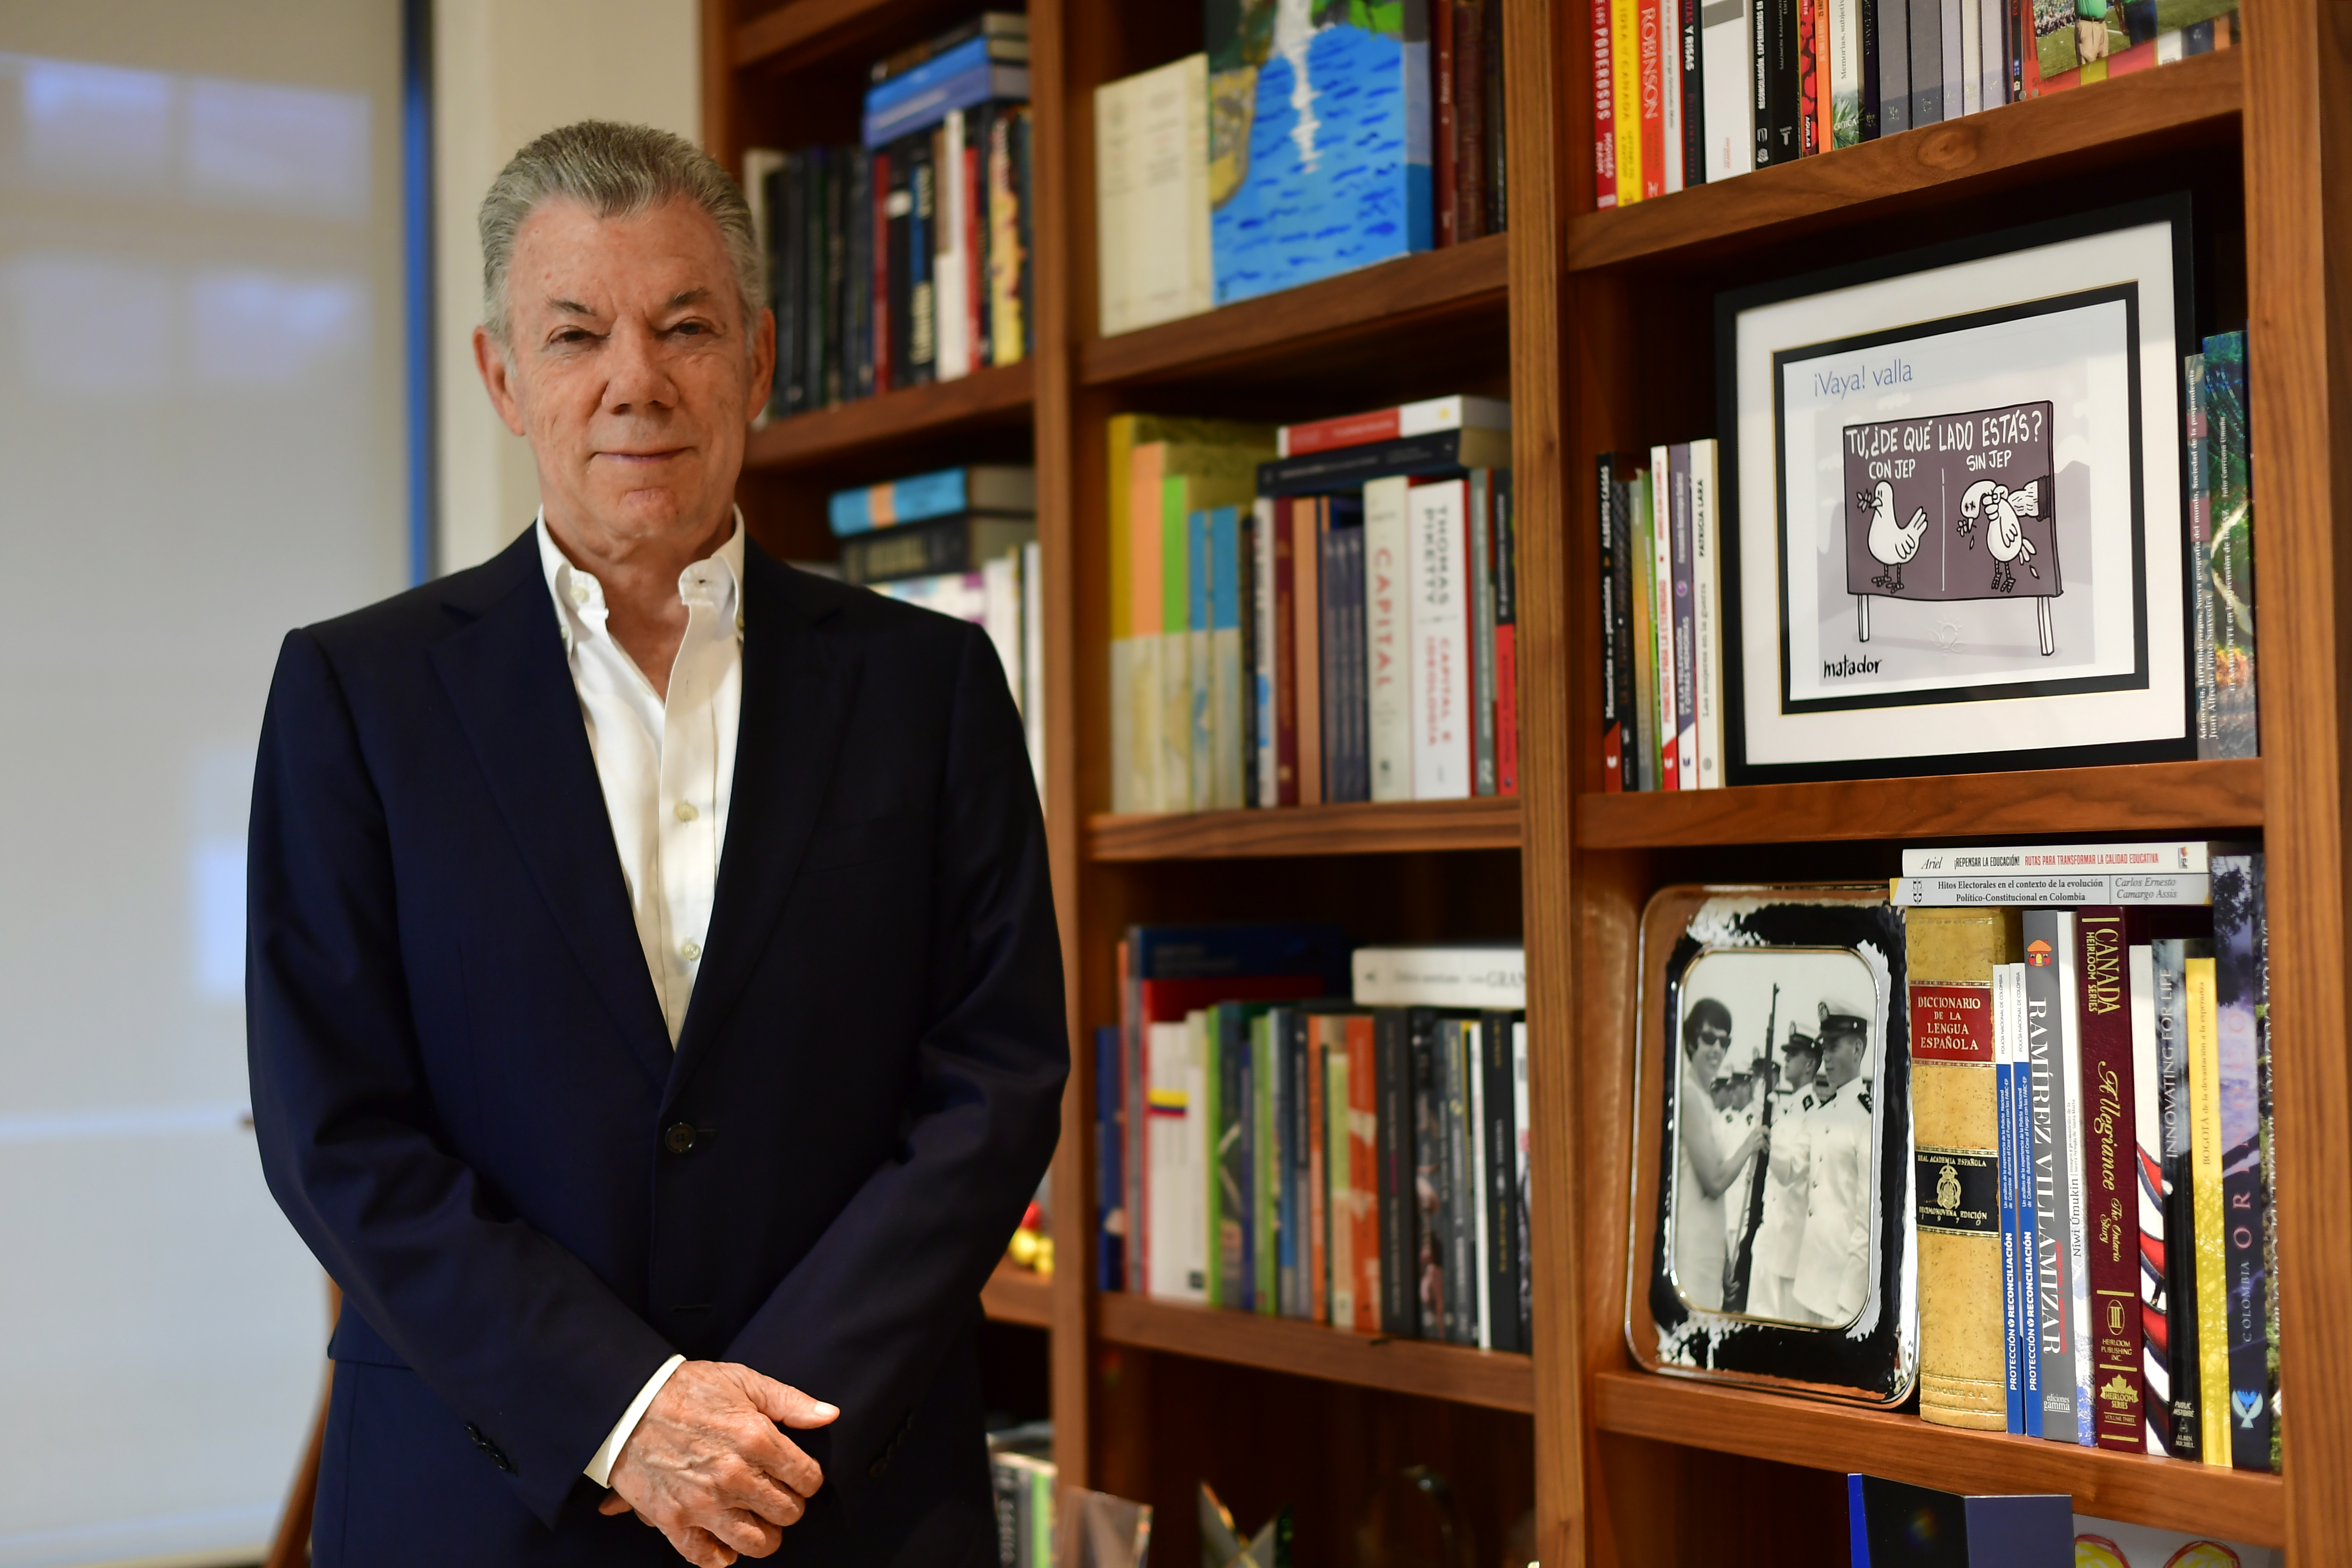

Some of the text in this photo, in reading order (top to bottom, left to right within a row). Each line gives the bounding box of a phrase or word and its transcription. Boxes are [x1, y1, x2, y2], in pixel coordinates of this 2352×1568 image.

[1838, 0, 1848, 31] subjetiv
[1641, 7, 1658, 119] ROBINSON
[1685, 25, 1695, 71] Y RISAS
[1595, 28, 1611, 120] PODEROSOS
[1814, 359, 1913, 400] ¡Vaya! valla
[2188, 370, 2198, 426] pospandemia
[1903, 420, 1933, 452] QUÉ
[1938, 420, 1974, 451] LADO
[2190, 428, 2197, 436] la
[2190, 439, 2198, 449] de
[1868, 458, 1916, 480] CON JEP
[1966, 450, 2012, 472] SIN JEP
[2191, 451, 2199, 489] Sociedad
[2218, 417, 2229, 498] Julio Carrizosa Umaña
[1600, 466, 1611, 549] ALBERTO CASAS
[2192, 490, 2200, 524] mundo,
[1423, 508, 1435, 605] PIKETTY
[1437, 505, 1449, 606] THOMAS
[2194, 542, 2202, 580] geografía
[1373, 548, 1393, 688] CAPITAL
[2223, 542, 2236, 691] El AMBIENTE en de
[1702, 634, 1707, 648] en
[1439, 637, 1451, 719] CAPITAL
[1823, 655, 1882, 679] matador
[2205, 595, 2219, 740] Juan Alfredo Pinto Saavedra
[1921, 856, 1943, 869] Ariel
[1983, 857, 1989, 867] LA
[1990, 854, 2020, 867] EDUCACIÓN!
[2025, 856, 2041, 866] RUTAS
[2042, 855, 2056, 866] PARA
[2057, 854, 2096, 865] TRANSFORMAR
[2097, 854, 2104, 864] LA
[2105, 853, 2128, 864] CALIDAD
[2129, 853, 2159, 864] EDUCATIVA
[1938, 881, 1956, 890] Hitos
[1958, 880, 1996, 889] Electorales
[2007, 880, 2014, 888] el
[2048, 879, 2057, 887] de
[2058, 879, 2065, 887] la
[2066, 879, 2103, 887] evolución
[1956, 893, 2037, 902] Político-Constitucional
[2050, 892, 2086, 901] Colombia
[2115, 877, 2177, 887] Carlos Ernesto
[2116, 889, 2177, 900] Camargo Assis
[2086, 931, 2098, 1012] HEIRLOOM SERIES
[2095, 928, 2121, 1015] CANADA
[1917, 996, 1981, 1009] DICCIONARIO
[1934, 1011, 1962, 1020] DE LA
[2198, 982, 2208, 1023] esperanza
[1921, 1035, 1979, 1050] ESPAÑOLA
[1927, 1022, 1969, 1035] LENGUA
[2159, 969, 2179, 1158] INNOVATING FOR LIFE
[2199, 1043, 2208, 1091] devastación
[2201, 1104, 2209, 1114] de
[2094, 1060, 2121, 1191] Allegiance
[2200, 1117, 2211, 1165] BOGOTÁ
[1929, 1156, 1956, 1165] ACADEMIA
[1957, 1157, 1987, 1167] ESPAÑOLA
[2028, 997, 2061, 1355] RAMÍREZ VILLAMIZAR
[2230, 1012, 2253, 1342] COLOMBIA ORINOCO
[1919, 1206, 1988, 1220] DECIMONOVENA EDICIÓN
[2069, 1179, 2082, 1258] Niwi Úmukin
[2099, 1214, 2111, 1244] Story
[2110, 1198, 2123, 1262] The Ontario
[2003, 1232, 2017, 1391] PROTECCIÓN RECONCILIACIÓN
[2023, 1232, 2037, 1391] PROTECCIÓN RECONCILIACIÓN
[2101, 1346, 2133, 1355] PUBLISHING
[2102, 1339, 2131, 1347] HEIRLOOM
[2044, 1401, 2070, 1411] gamma
[2047, 1393, 2070, 1403] ediciones
[2104, 1391, 2135, 1402] HEIRLOOM
[2111, 1401, 2128, 1410] SERIES
[2175, 1440, 2195, 1448] MICHEL
[2176, 1434, 2193, 1442] ALBIN
